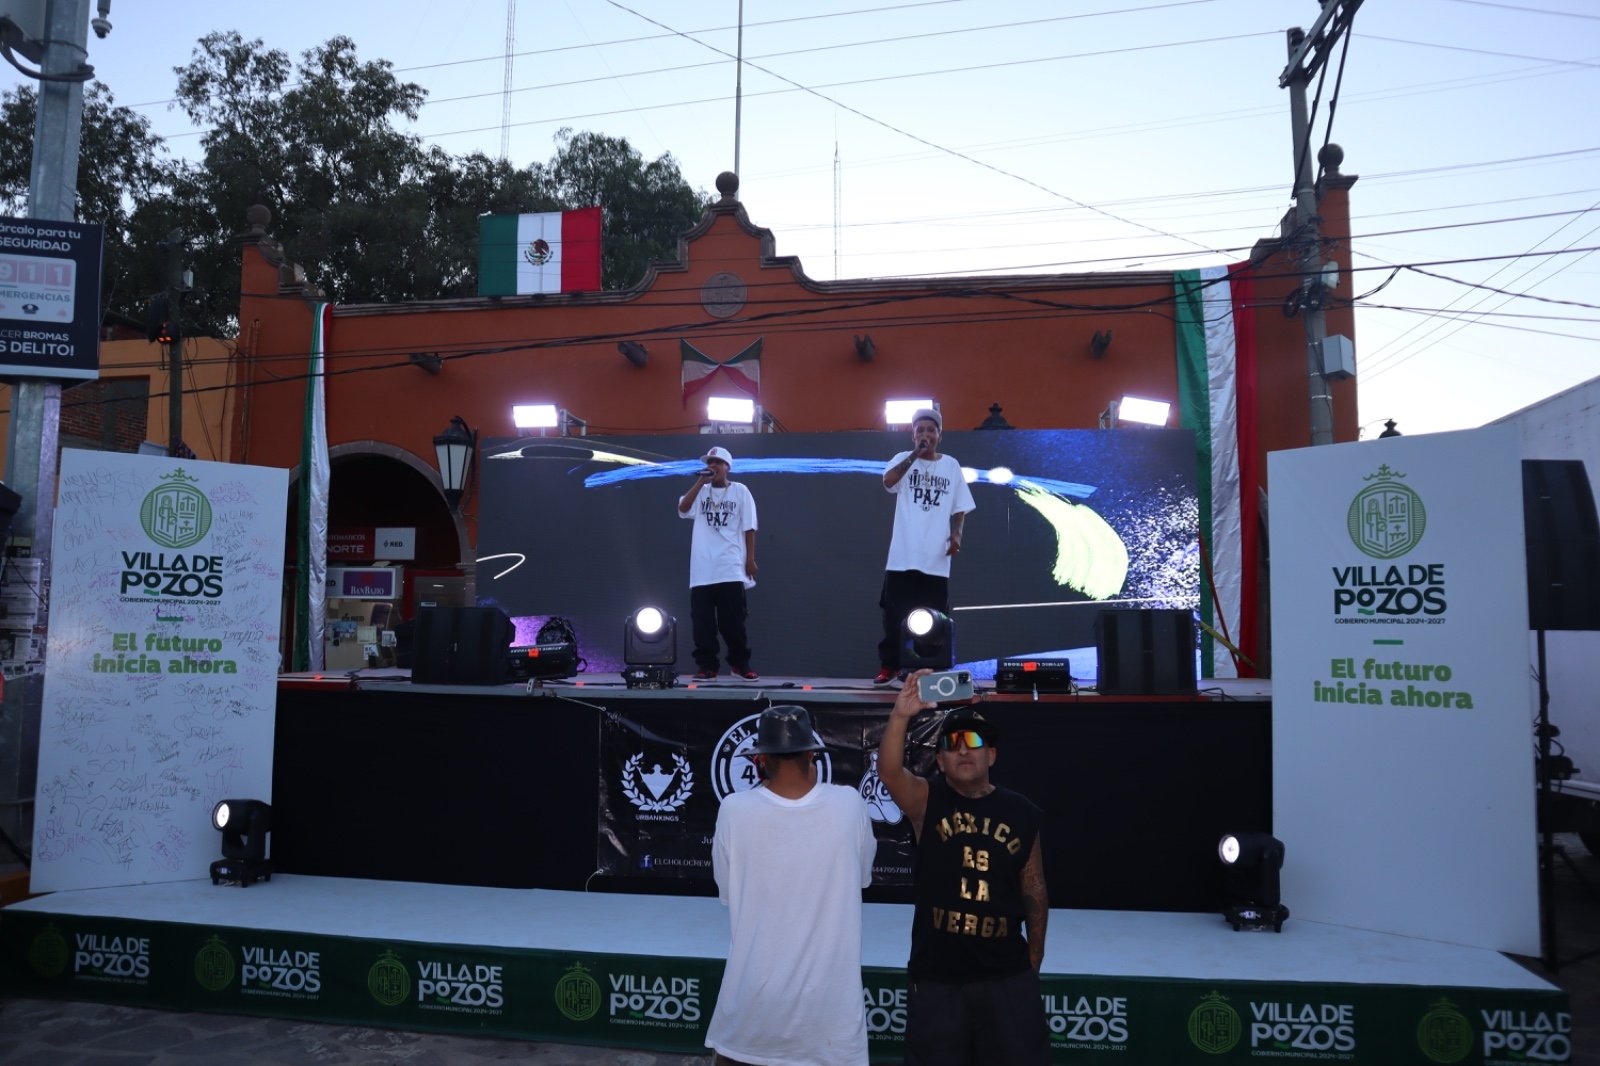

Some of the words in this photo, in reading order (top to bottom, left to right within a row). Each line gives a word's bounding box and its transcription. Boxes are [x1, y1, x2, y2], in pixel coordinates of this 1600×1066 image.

[37, 227, 66, 239] para
[69, 229, 81, 239] tu
[23, 330, 70, 341] BROMAS
[11, 341, 74, 357] DELITO!
[913, 488, 940, 506] PAZ
[706, 512, 728, 526] PAZ
[122, 551, 191, 573] VILLA
[192, 555, 223, 574] DE
[120, 572, 223, 597] POZOS
[1332, 565, 1405, 587] VILLA
[1408, 564, 1445, 586] DE
[1334, 587, 1447, 615] POZOS
[113, 633, 137, 652] El
[144, 633, 222, 653] futuro
[92, 654, 161, 674] inicia
[168, 655, 238, 674] ahora
[1331, 658, 1356, 679] El
[1363, 658, 1452, 682] futuro
[1313, 681, 1383, 706] inicia
[1391, 685, 1474, 710] ahora
[728, 725, 752, 746] EL
[935, 810, 1022, 856] MEXICO
[962, 845, 990, 872] ES
[959, 876, 991, 902] LA
[932, 906, 1009, 938] VERGA
[75, 933, 124, 953] VILLA
[126, 936, 150, 955] DE
[241, 945, 294, 967] VILLA
[294, 951, 320, 970] DE
[417, 960, 474, 982] VILLA
[475, 965, 503, 984] DE
[608, 973, 669, 995] VILLA
[671, 977, 700, 996] DE
[878, 987, 908, 1008] DE
[1041, 994, 1093, 1015] ILLA
[1095, 996, 1127, 1017] DE
[1249, 1001, 1319, 1023] VILLA
[1320, 1004, 1355, 1025] DE
[1480, 1009, 1554, 1032] VILLA
[1046, 1015, 1129, 1043] OZOS
